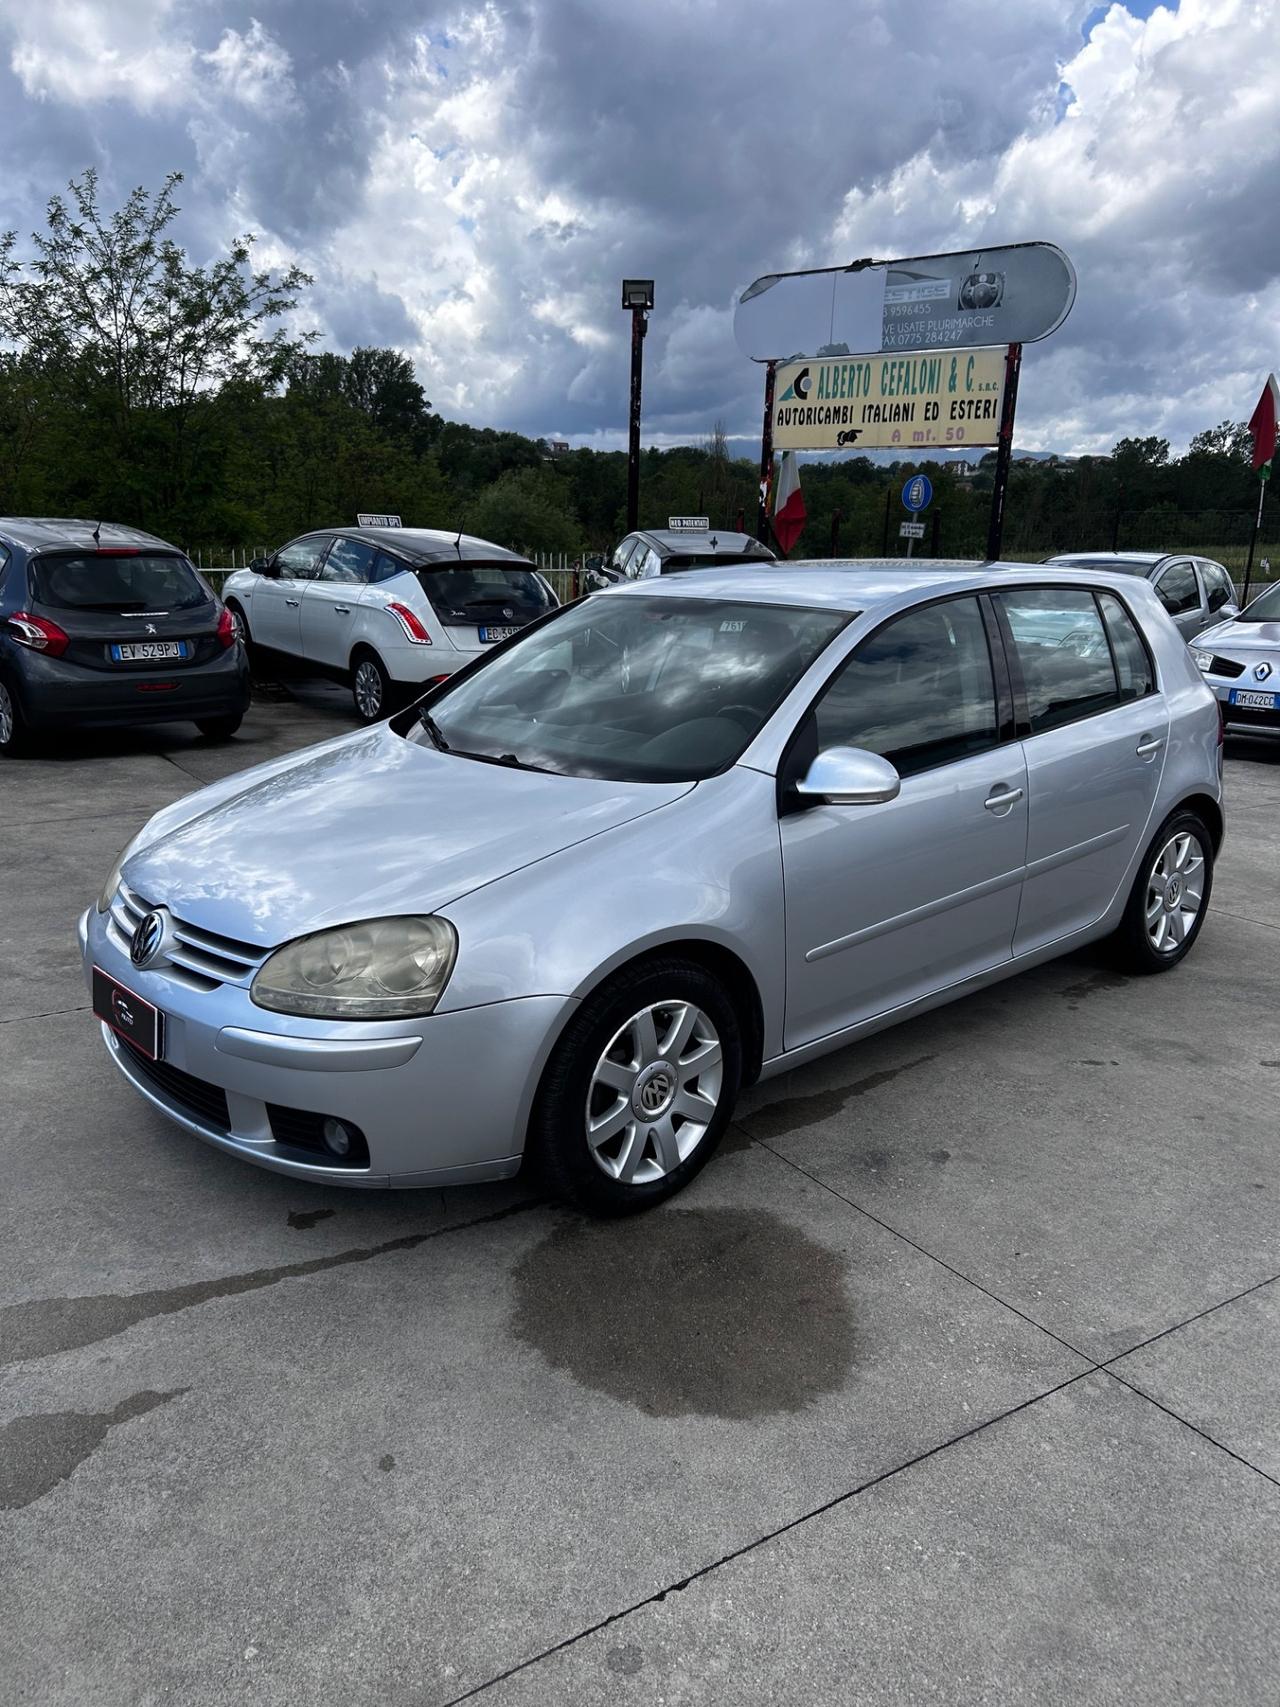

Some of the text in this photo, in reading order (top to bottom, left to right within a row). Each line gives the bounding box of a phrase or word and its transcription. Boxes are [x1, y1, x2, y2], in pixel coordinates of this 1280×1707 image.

[891, 304, 932, 316] 9596455
[897, 321, 925, 333] USATE
[928, 315, 995, 331] PLURIMARCHE
[899, 334, 921, 345] 0775
[926, 330, 963, 343] 284247
[817, 362, 871, 400] ALBERTO
[881, 358, 942, 397] CEFALONI
[948, 356, 957, 393] &
[966, 355, 975, 392] C.
[777, 398, 998, 426] AUTORICAMBI ITALIANI ED ESTERI
[891, 428, 902, 442] A
[945, 426, 965, 441] 50
[487, 628, 498, 639] EC
[120, 643, 179, 658] EV 529PJ
